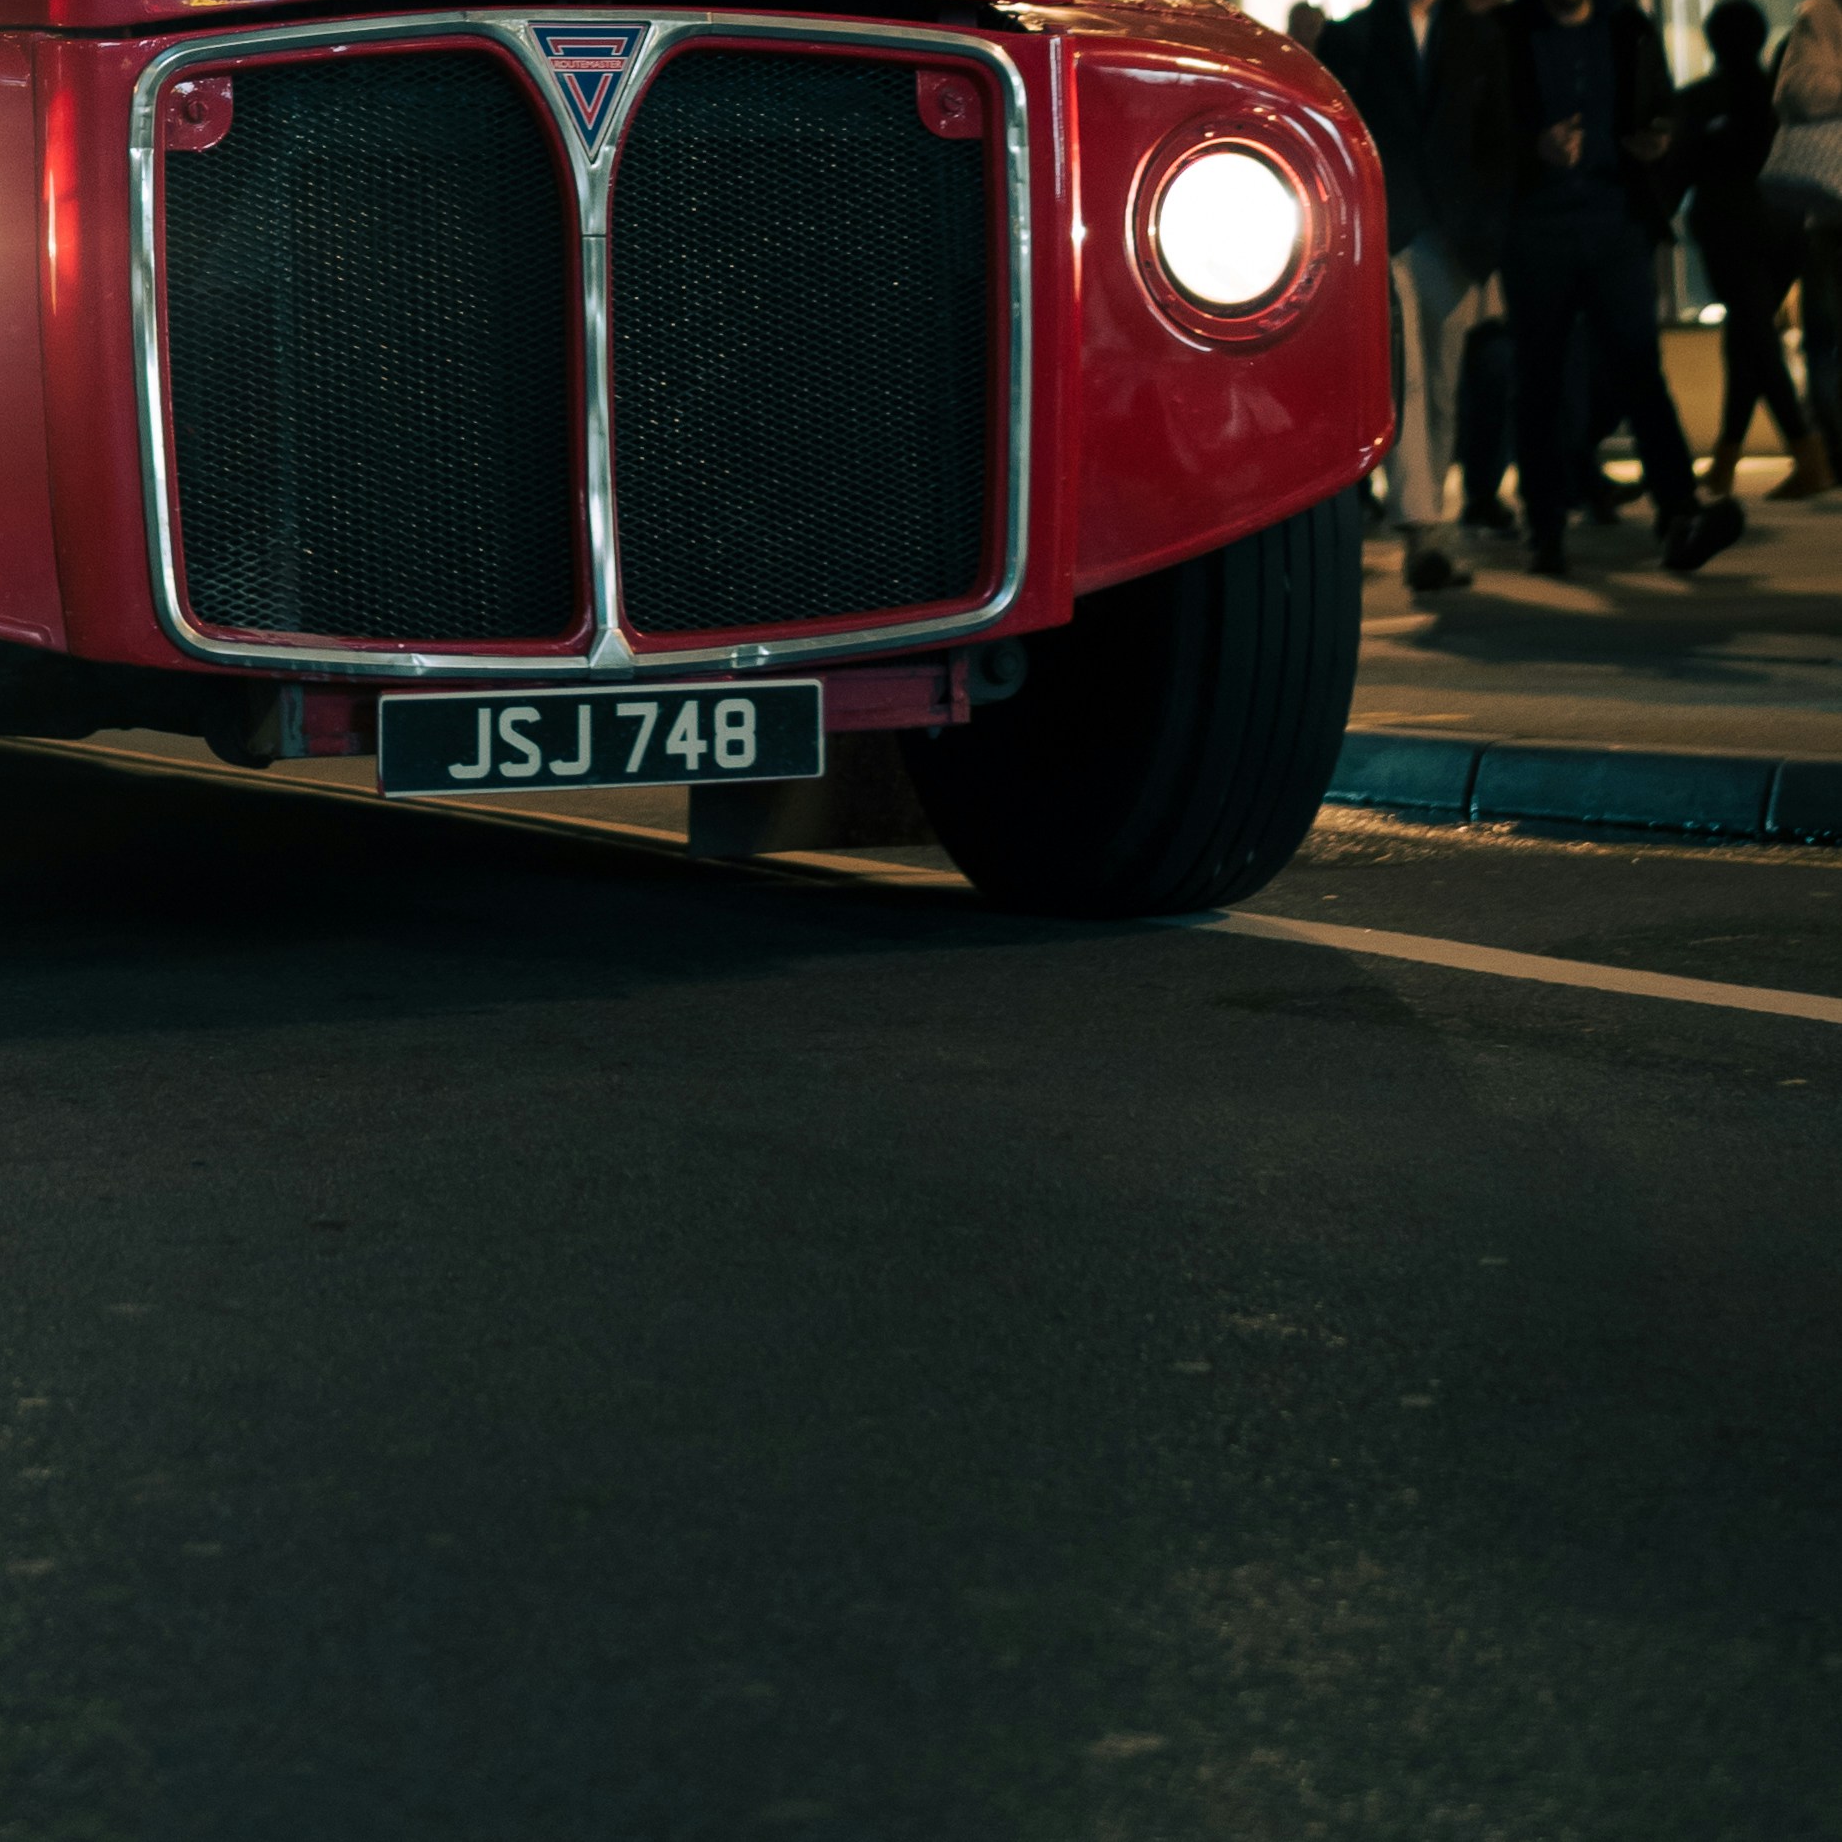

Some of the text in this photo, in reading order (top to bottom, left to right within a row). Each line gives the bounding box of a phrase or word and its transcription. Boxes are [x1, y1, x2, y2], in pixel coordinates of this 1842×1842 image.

[551, 59, 623, 70] ROUTEMASTER
[447, 697, 757, 780] JSJ 748
